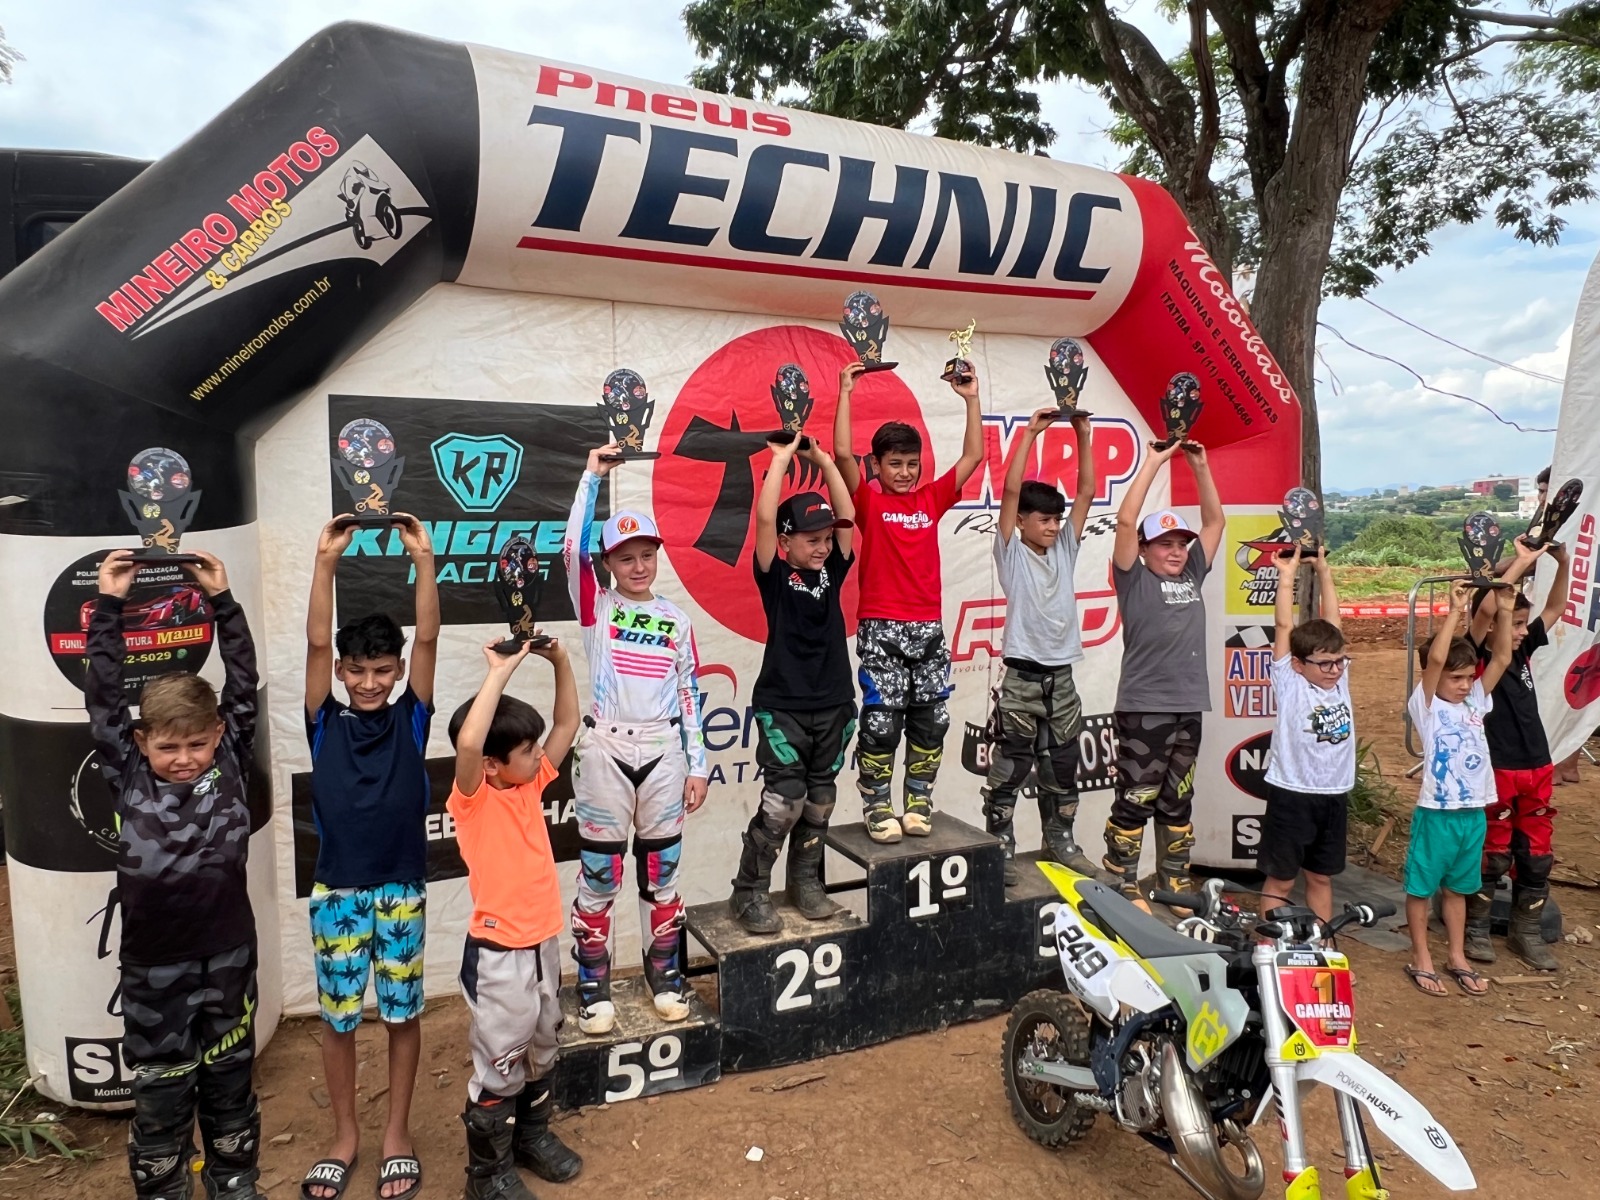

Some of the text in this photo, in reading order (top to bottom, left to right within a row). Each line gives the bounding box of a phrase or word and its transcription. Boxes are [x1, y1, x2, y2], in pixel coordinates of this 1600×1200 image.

[536, 65, 791, 137] Pneus
[527, 105, 1122, 283] TECHNIC
[95, 126, 340, 333] MINEIRO MOTOS
[204, 198, 292, 290] & CARROS
[190, 275, 331, 401] www.mineiromotos.com.br
[1160, 291, 1192, 335] ITATIBA
[1192, 340, 1205, 355] SP
[1201, 356, 1218, 379] (11)
[1211, 327, 1221, 340] E
[1218, 338, 1278, 424] FERRAMENTAS
[449, 450, 508, 499] KR
[1560, 513, 1596, 628] Pneus
[124, 651, 172, 664] 2-5029
[156, 626, 204, 646] Manu
[908, 855, 968, 918] 1º
[775, 942, 842, 1012] 2º
[1058, 924, 1109, 979] 249
[1295, 1001, 1352, 1018] CAMPEÃO
[605, 1034, 682, 1103] 5º
[1336, 1070, 1403, 1122] POWER HUSKY
[305, 1163, 345, 1183] VANS
[381, 1159, 419, 1179] VANS
